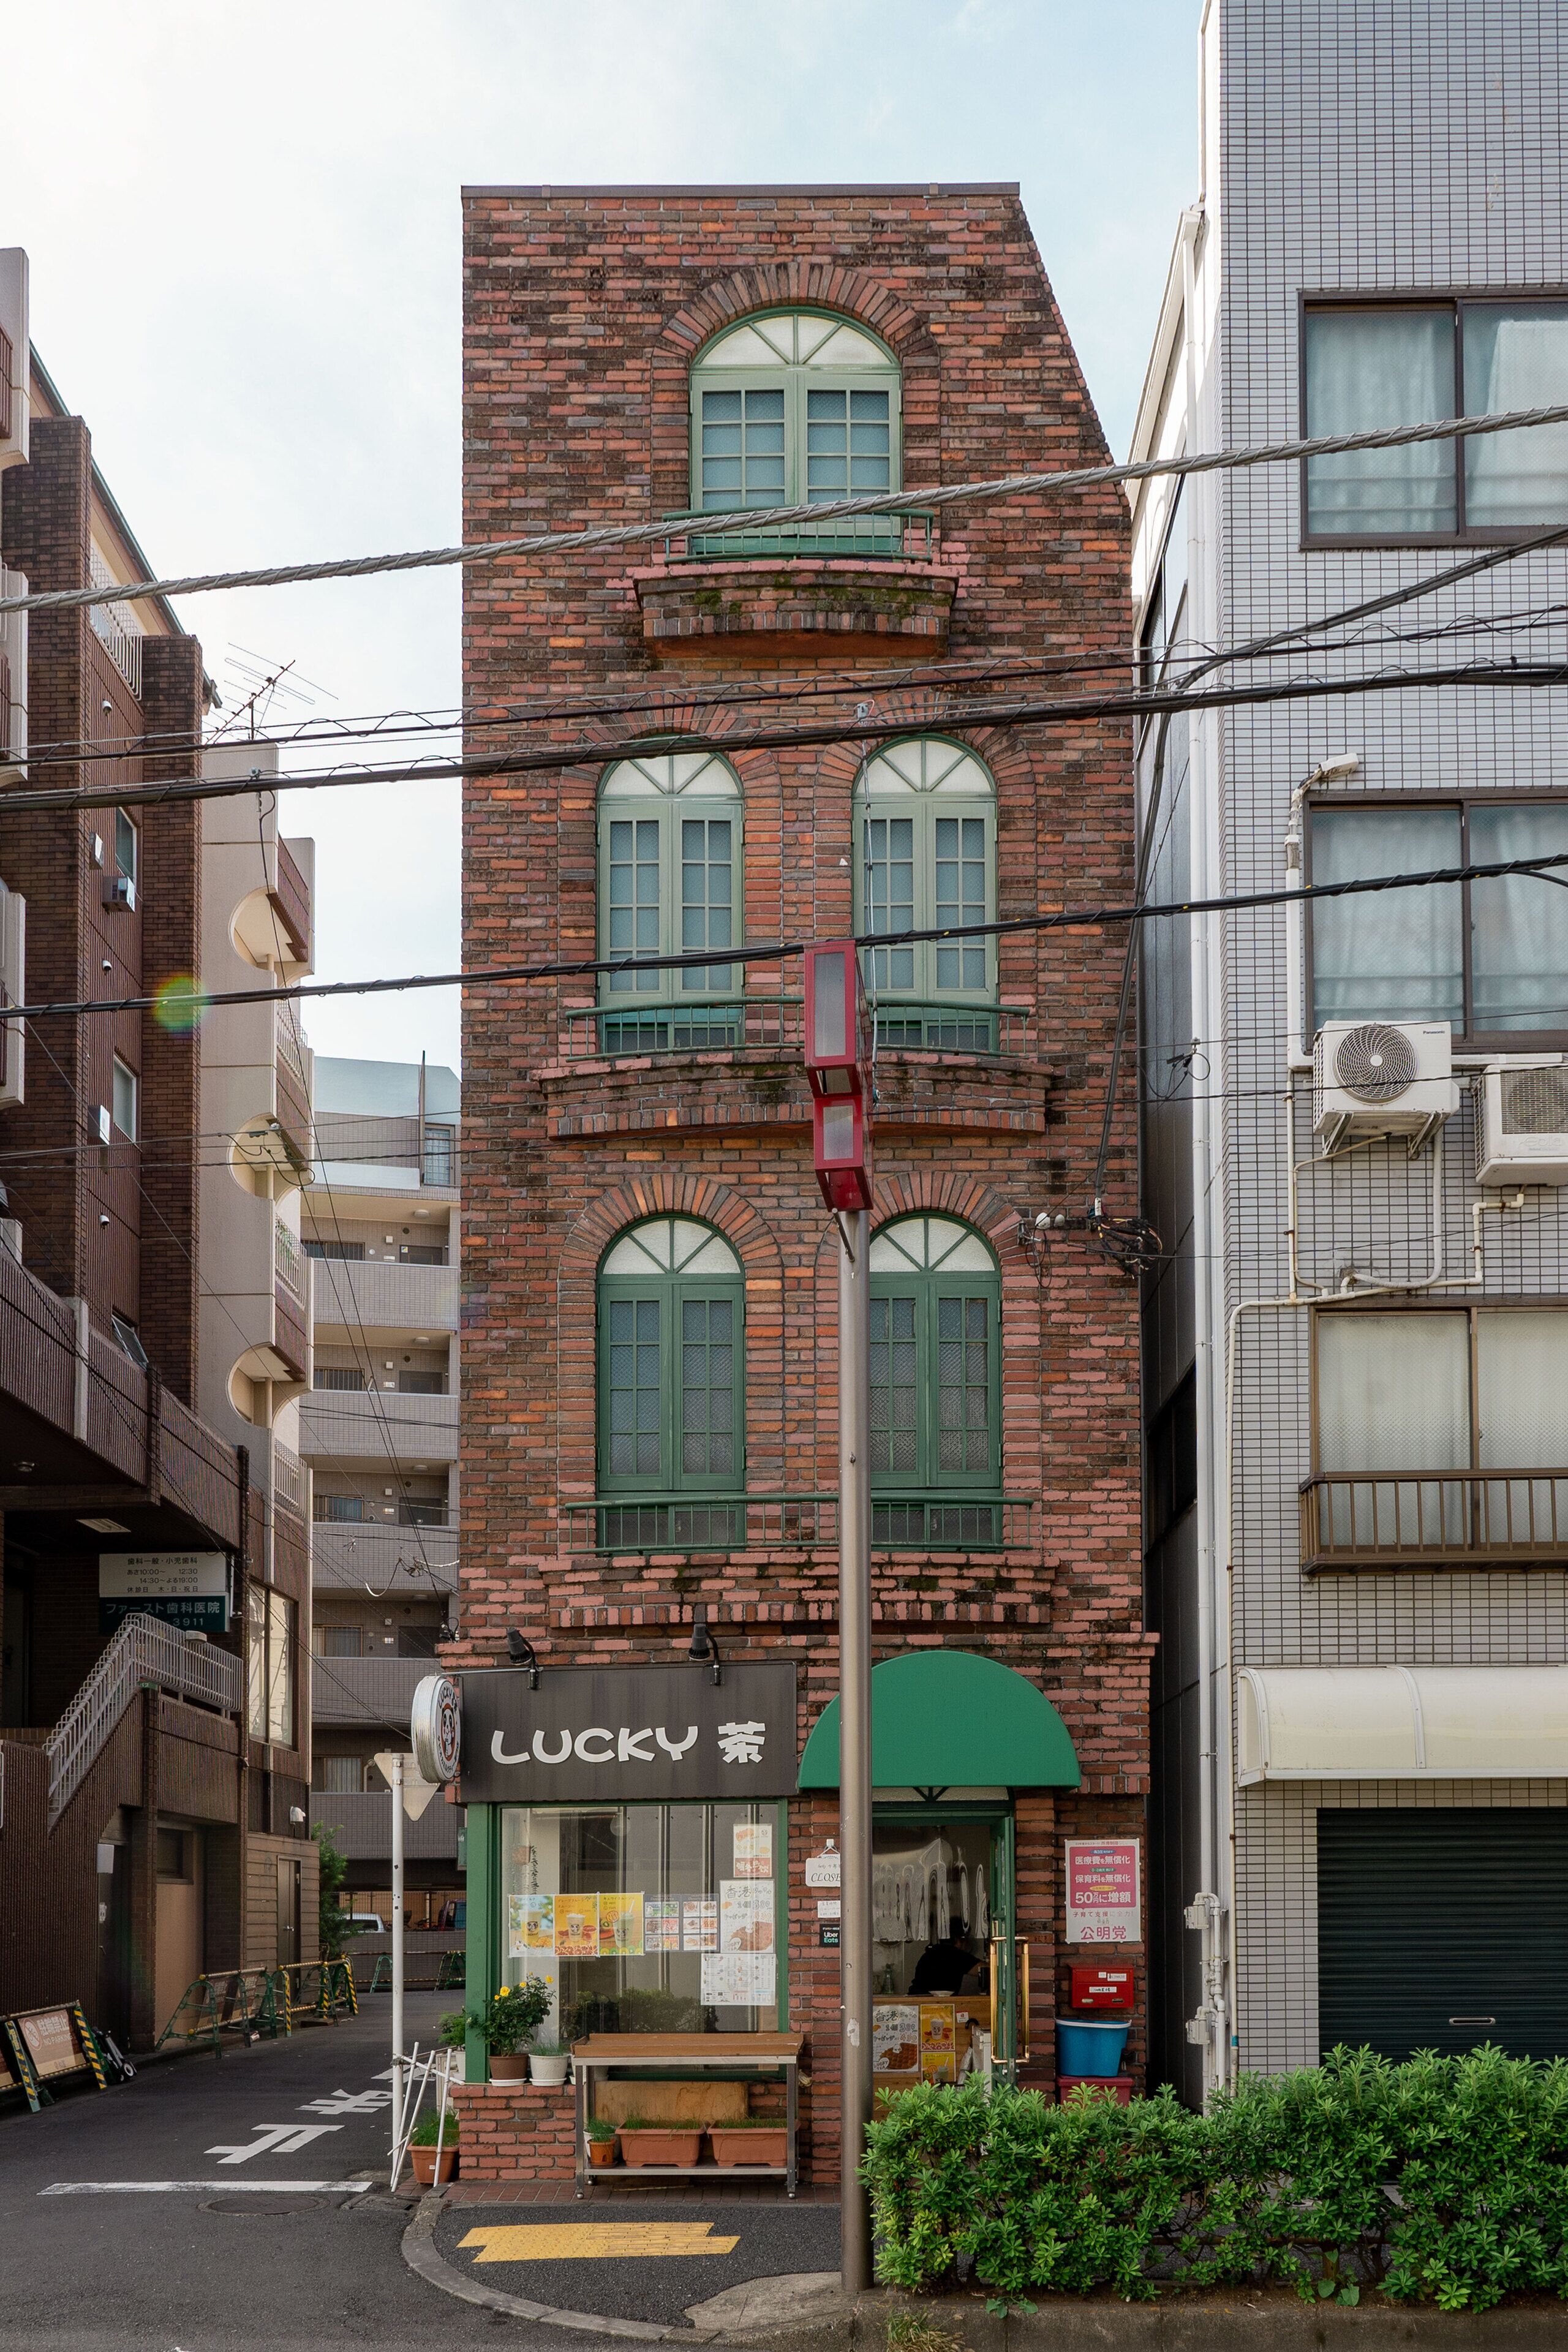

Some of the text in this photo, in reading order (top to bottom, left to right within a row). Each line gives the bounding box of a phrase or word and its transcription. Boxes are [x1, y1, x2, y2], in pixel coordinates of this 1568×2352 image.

[106, 1602, 221, 1614] ファースト歯科医院
[491, 1721, 766, 1765] LUCKY 茶
[1075, 1856, 1131, 1864] 医療費を無償化
[811, 1872, 840, 1883] CLOSE
[1080, 1926, 1126, 1940] 公明党
